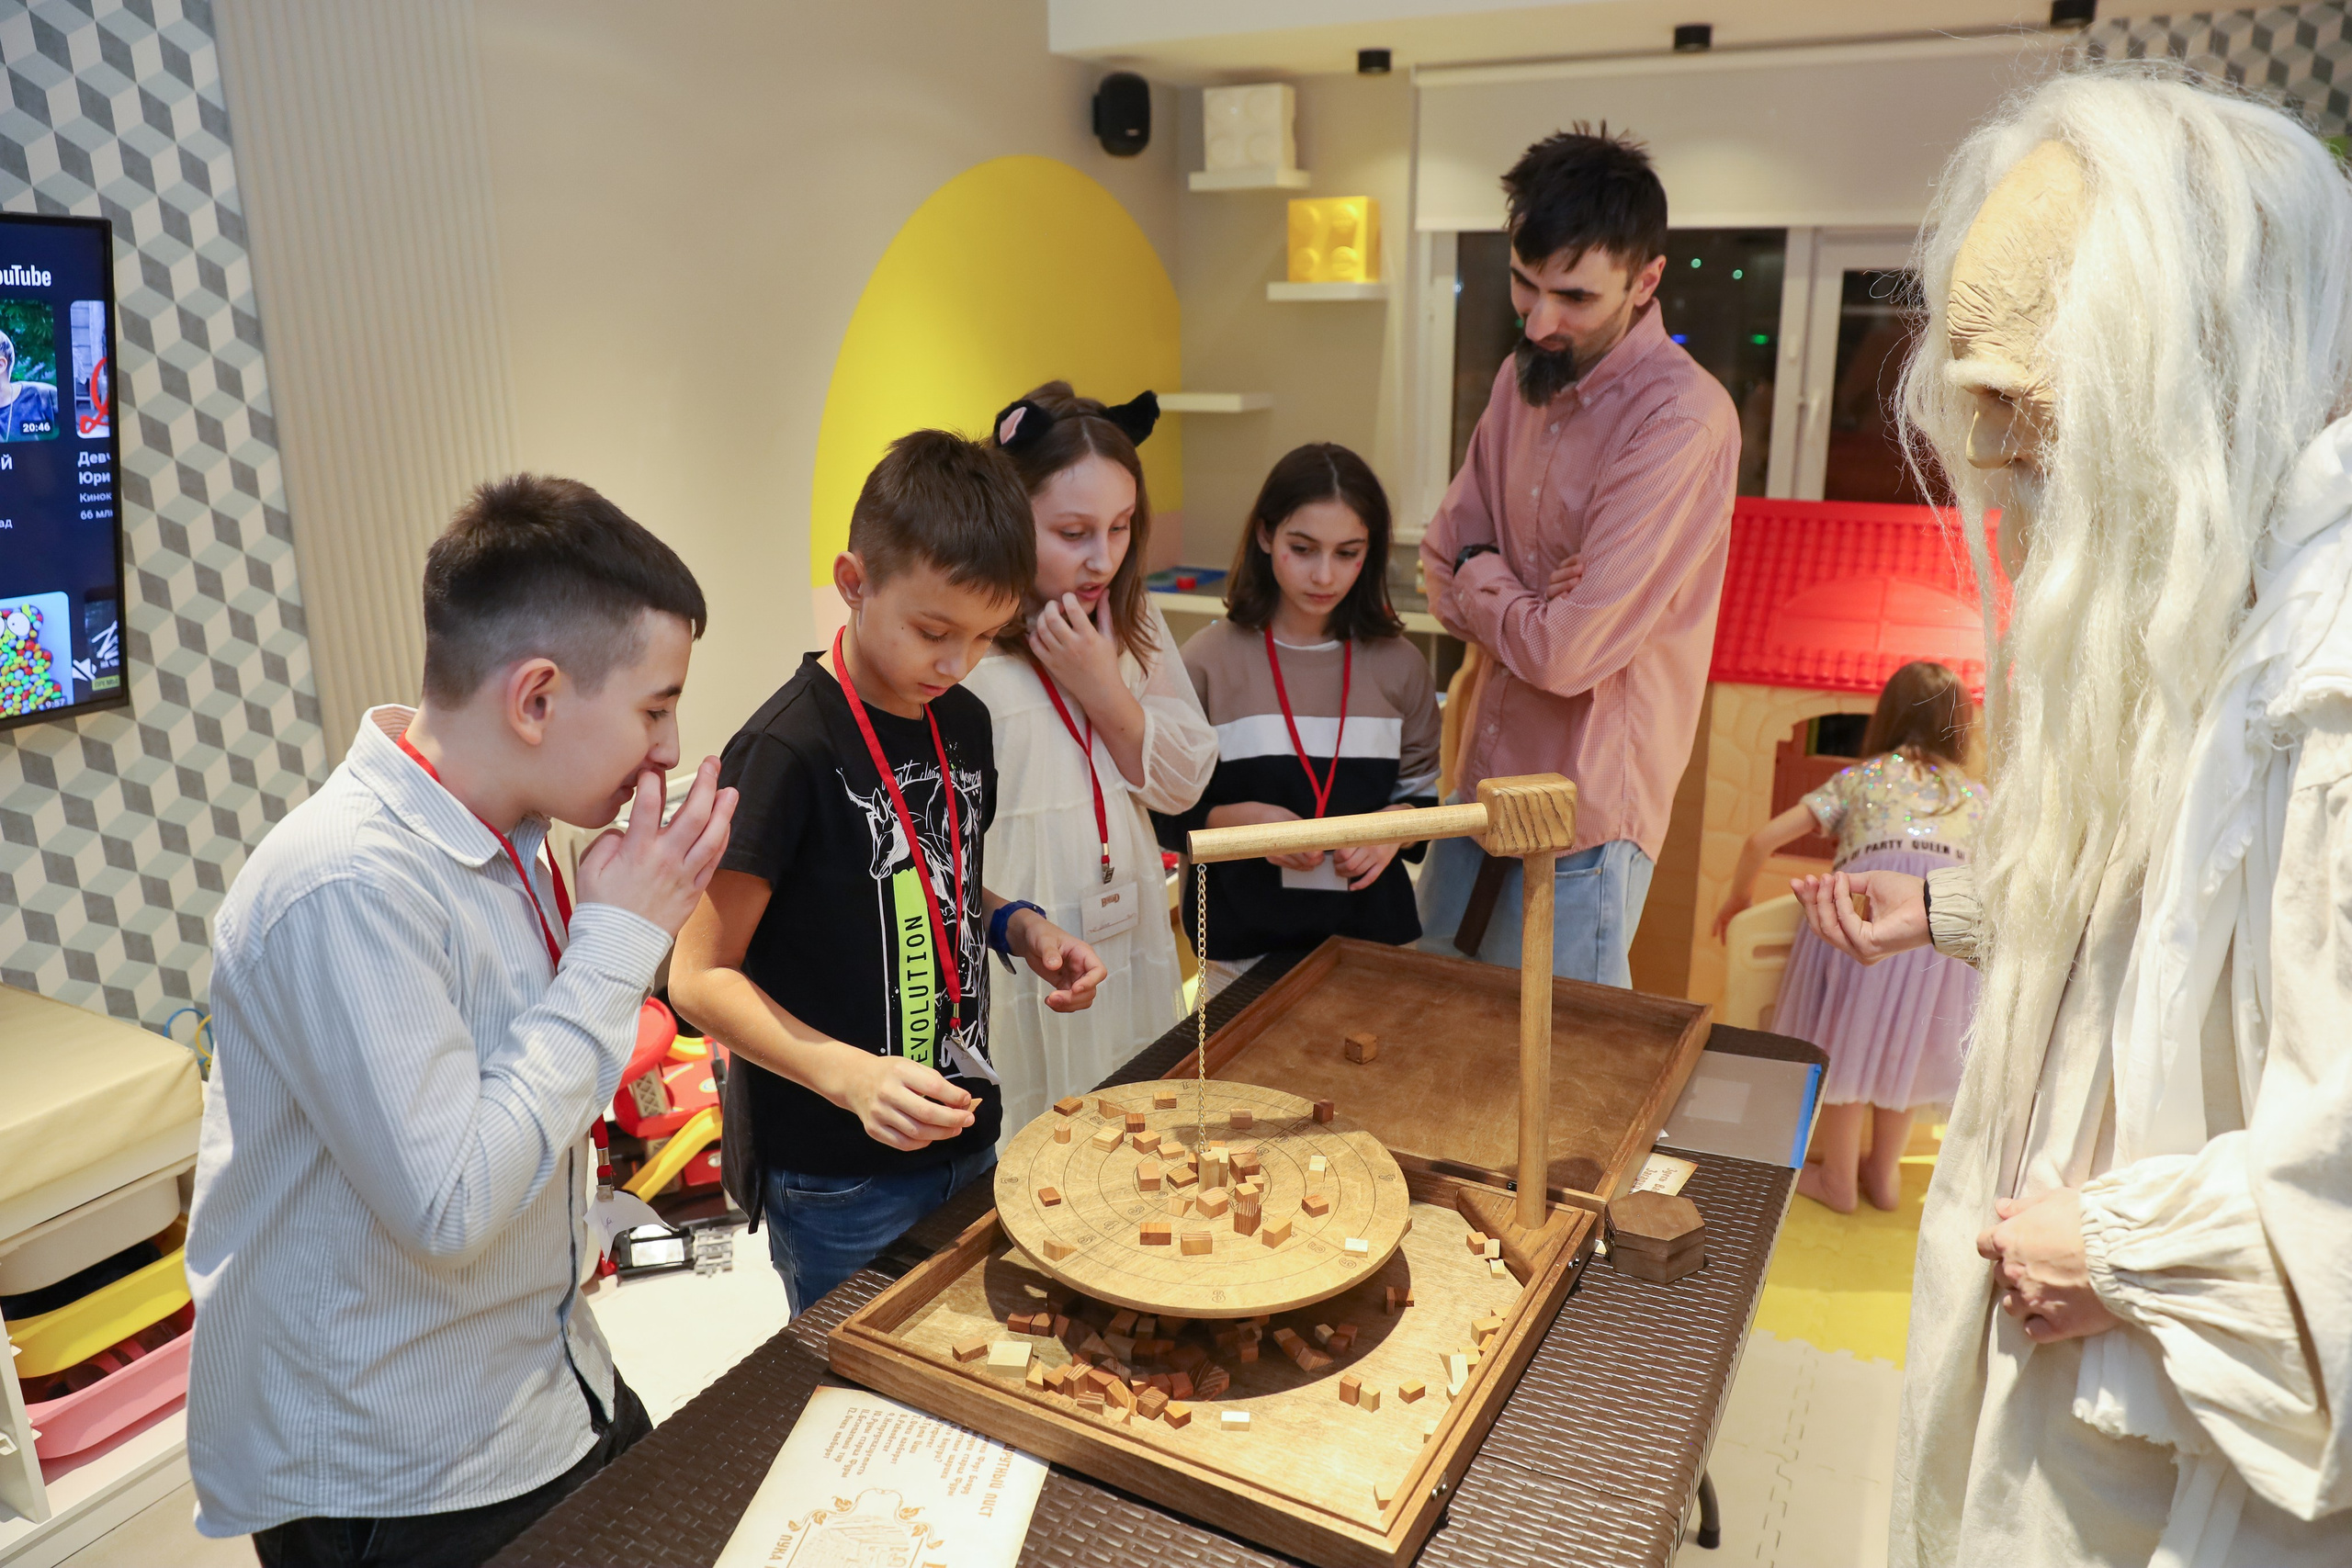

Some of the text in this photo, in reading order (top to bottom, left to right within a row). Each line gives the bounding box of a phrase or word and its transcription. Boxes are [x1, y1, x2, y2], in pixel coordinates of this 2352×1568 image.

[0, 265, 51, 287] uTube
[22, 423, 51, 433] 20:46
[80, 510, 94, 520] 66
[1865, 839, 1903, 854] PARTY
